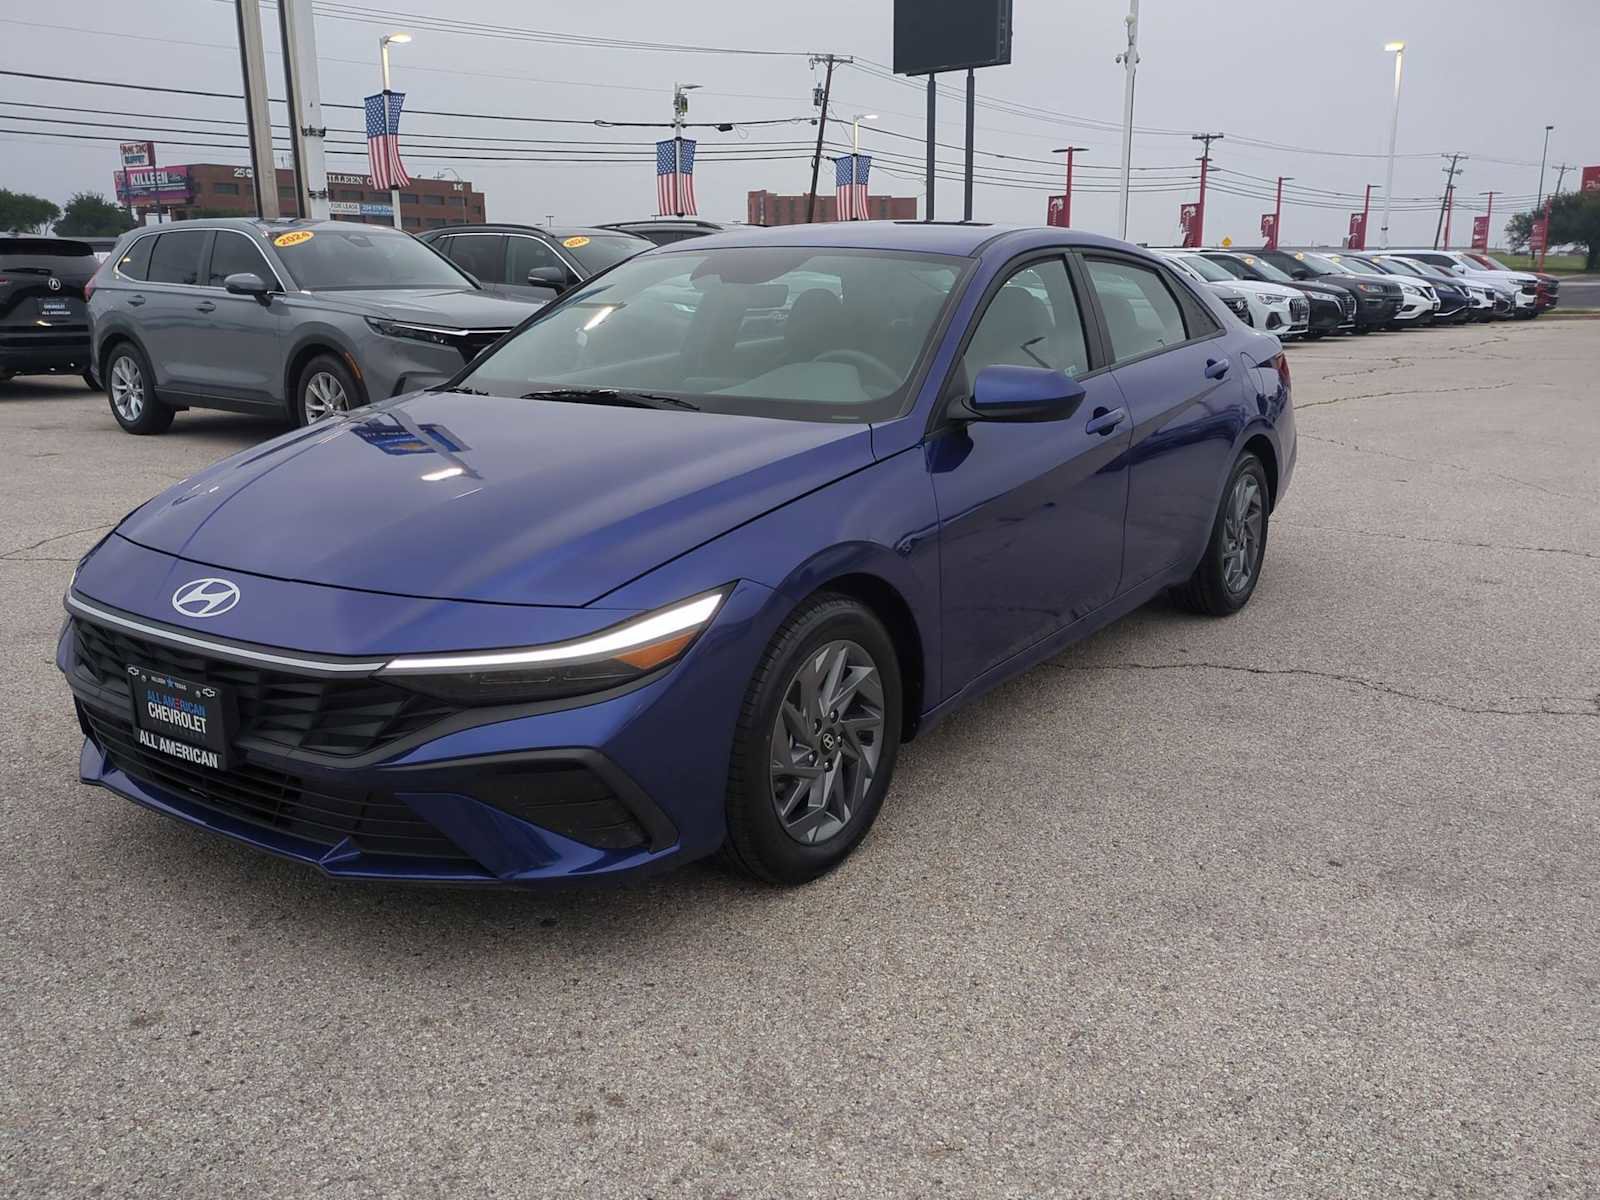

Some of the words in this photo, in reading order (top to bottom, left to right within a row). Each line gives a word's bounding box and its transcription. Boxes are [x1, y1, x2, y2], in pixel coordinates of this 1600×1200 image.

[130, 171, 168, 185] KILLEEN
[328, 174, 364, 185] ILLEEN
[147, 689, 160, 702] ALL
[164, 695, 206, 716] AMERICAN
[147, 701, 206, 734] CHEVROLET
[140, 730, 158, 749] ALL
[160, 737, 218, 768] AMERICAN
